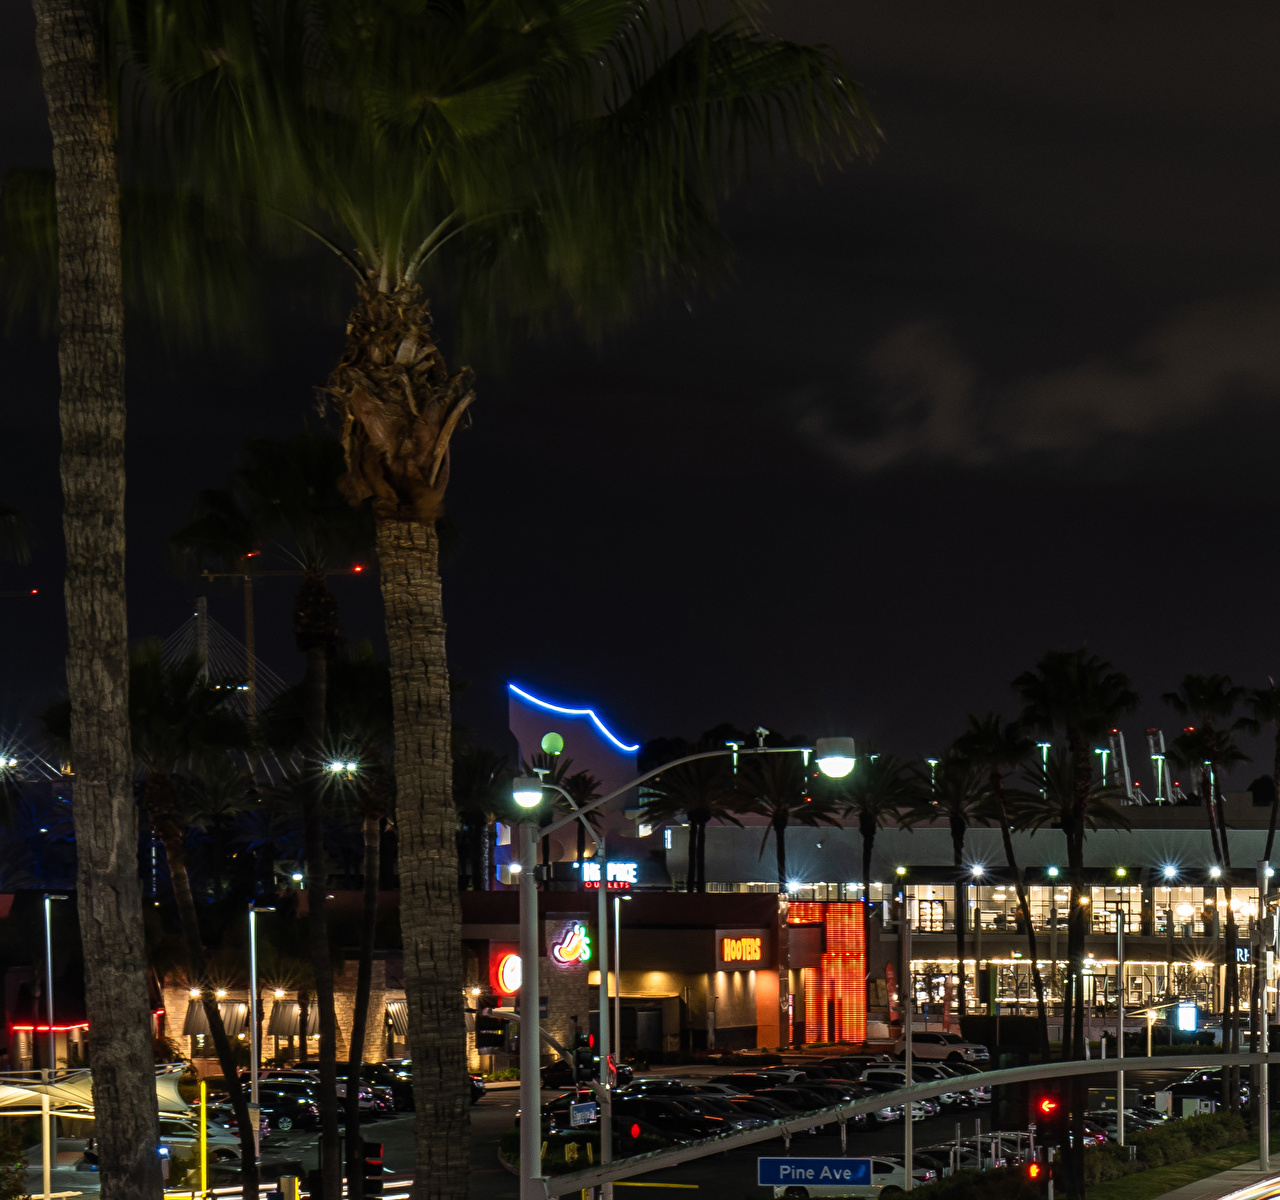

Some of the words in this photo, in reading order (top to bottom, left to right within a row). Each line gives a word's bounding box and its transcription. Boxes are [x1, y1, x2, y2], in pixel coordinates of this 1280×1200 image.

[584, 881, 630, 889] OULETS
[723, 937, 762, 962] HOOTERS
[780, 1165, 815, 1179] Pine
[819, 1165, 852, 1180] Ave
